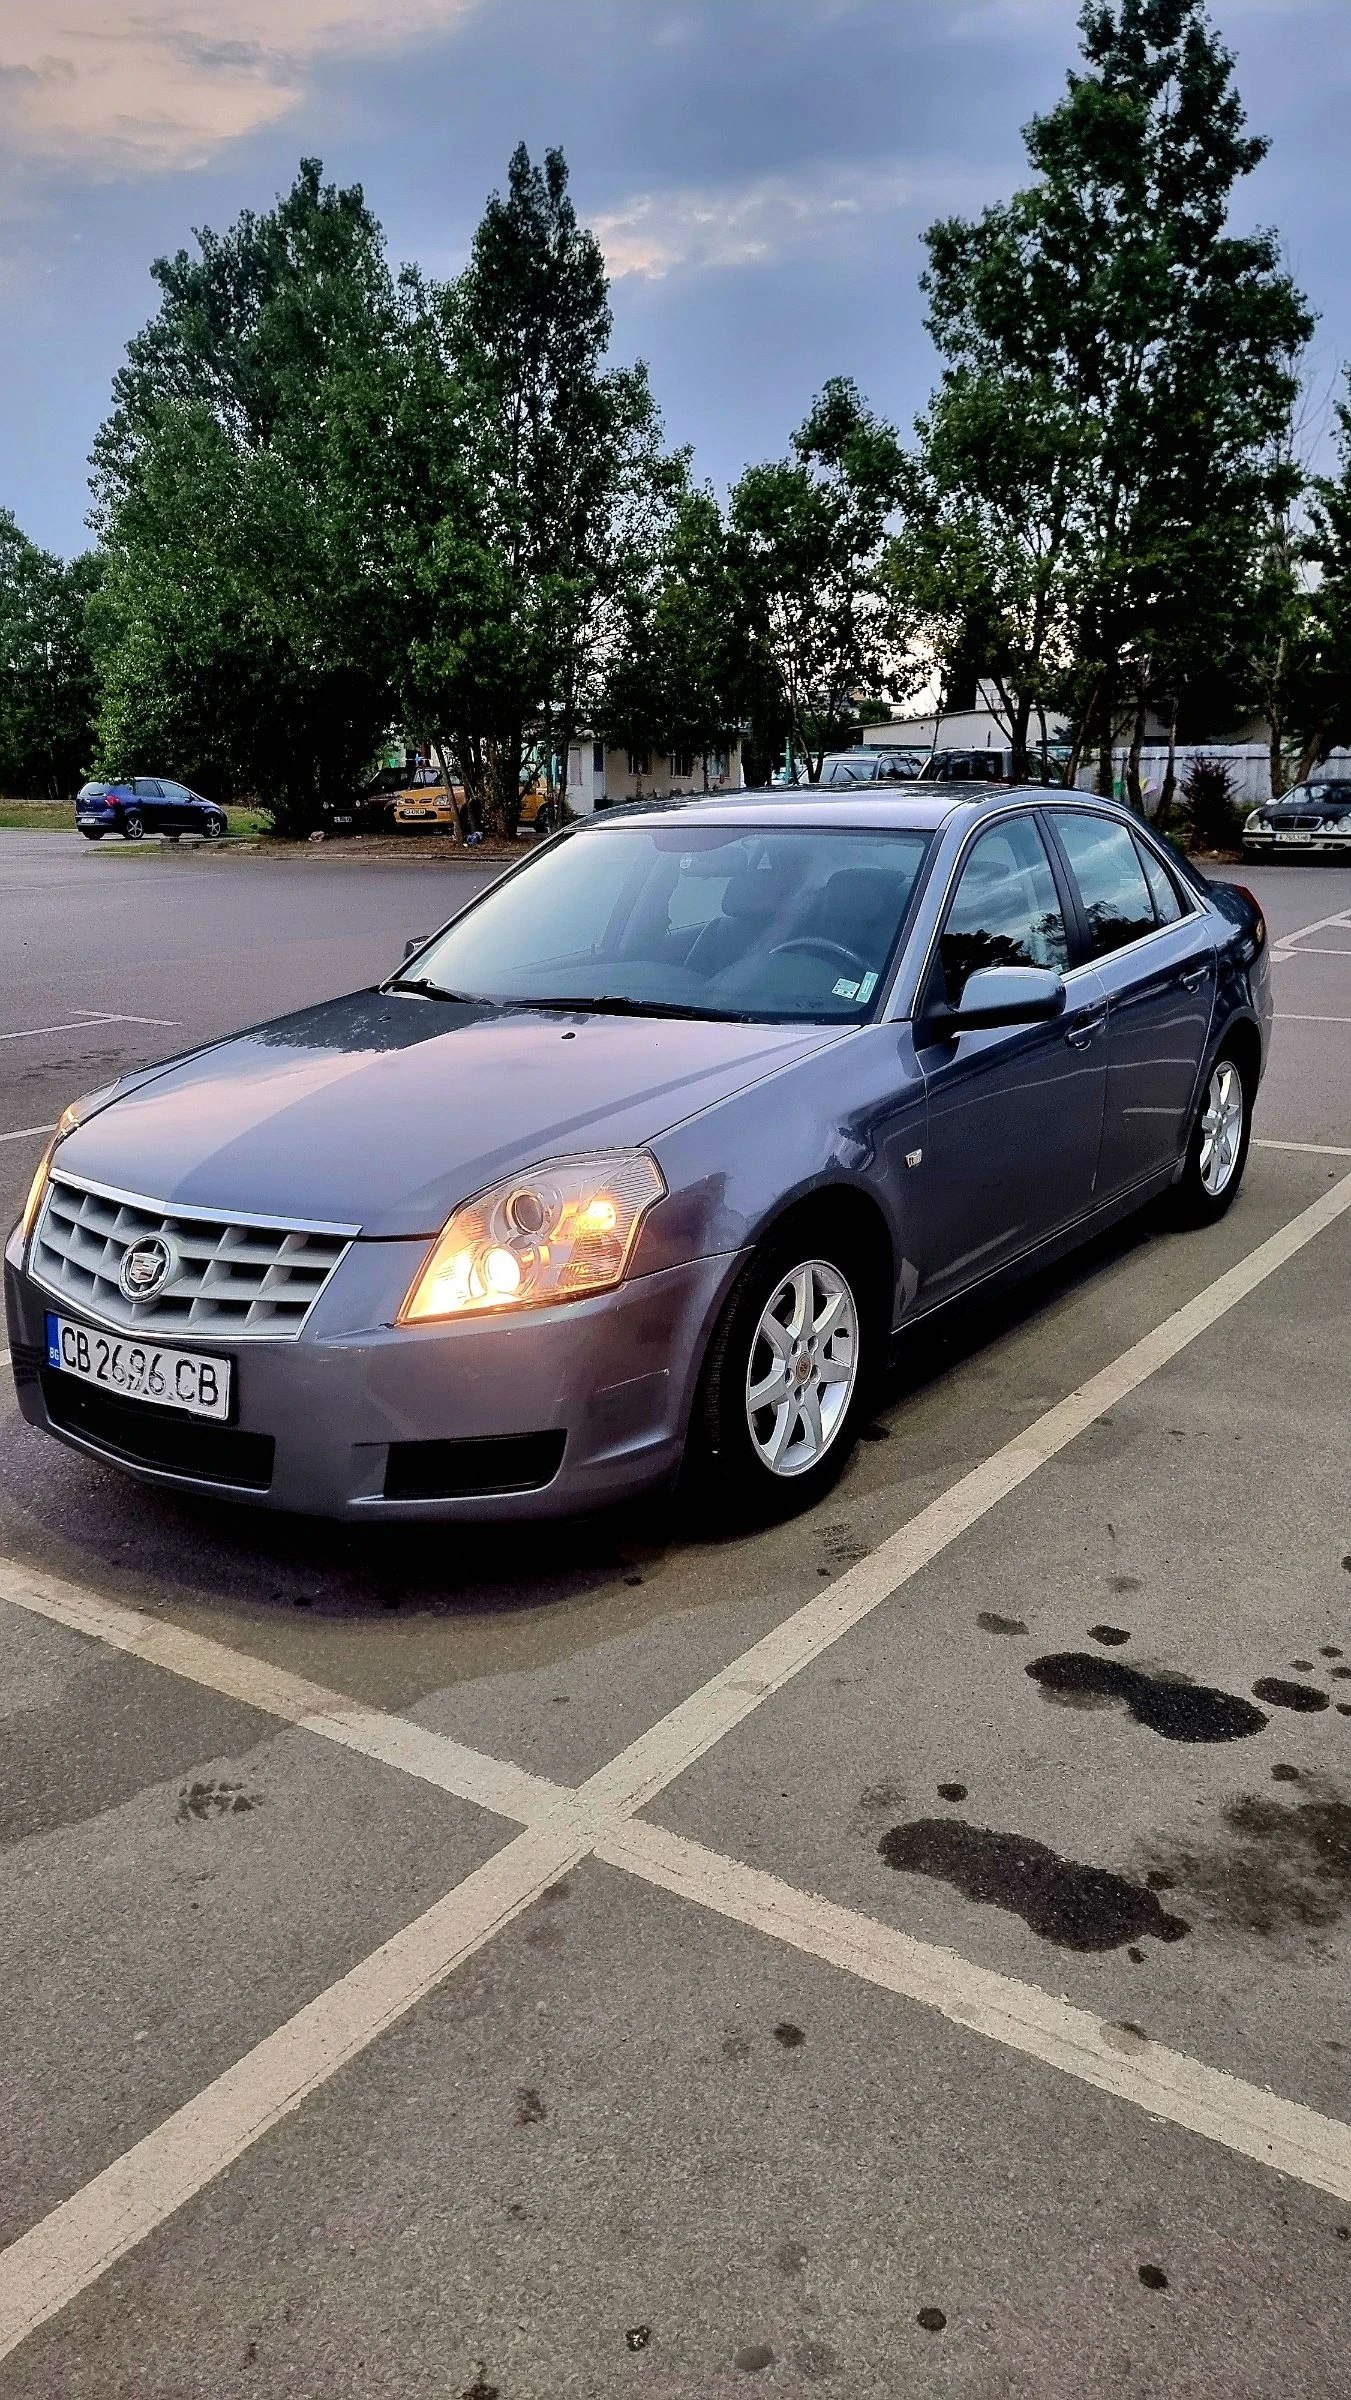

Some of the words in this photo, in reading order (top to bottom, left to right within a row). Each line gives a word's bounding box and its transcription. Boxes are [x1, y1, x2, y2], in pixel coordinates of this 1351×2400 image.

[49, 1346, 60, 1361] BG
[61, 1326, 91, 1373] CB
[95, 1338, 167, 1396] 2696
[175, 1358, 219, 1407] CB
